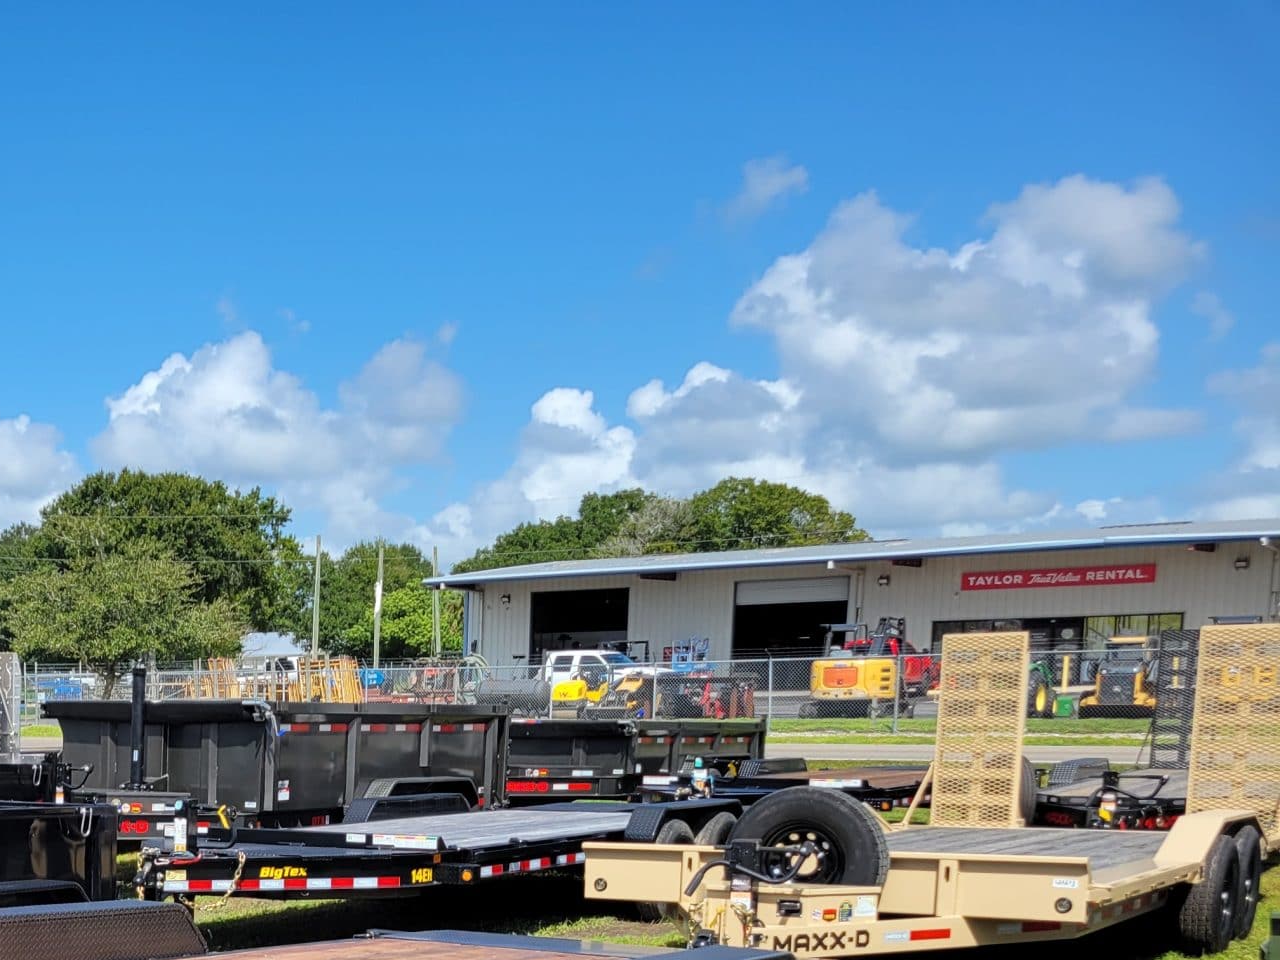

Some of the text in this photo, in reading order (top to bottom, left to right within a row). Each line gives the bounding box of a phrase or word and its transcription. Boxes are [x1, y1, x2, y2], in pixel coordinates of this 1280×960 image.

[968, 575, 1022, 586] TAYLOR
[1086, 568, 1145, 581] RENTAL
[259, 866, 308, 880] BigTex
[772, 930, 870, 953] MAXX-D
